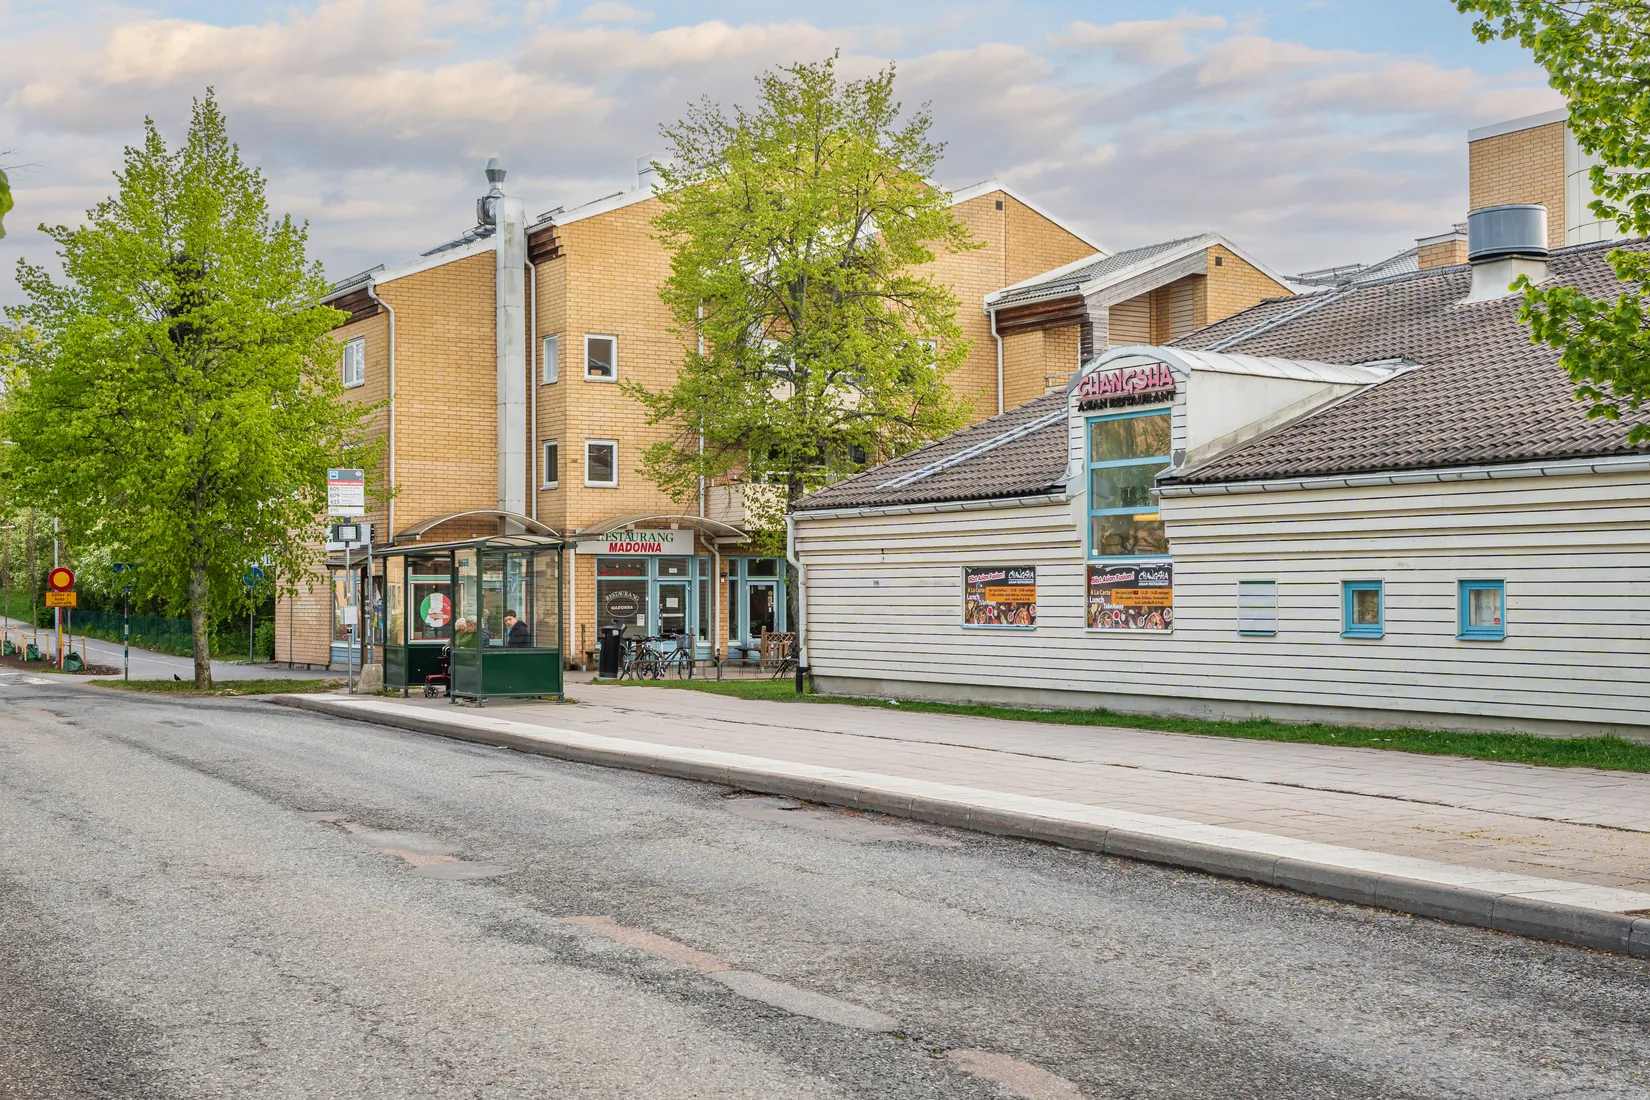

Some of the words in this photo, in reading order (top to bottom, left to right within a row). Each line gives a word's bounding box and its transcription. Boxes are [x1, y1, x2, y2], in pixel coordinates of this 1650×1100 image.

[1078, 362, 1174, 397] CHANGSHA
[1108, 390, 1175, 409] RESTAURANT
[601, 532, 674, 542] ESTAURANG
[609, 542, 662, 552] MADONNA
[1138, 568, 1169, 580] CHANGSHA
[605, 591, 640, 601] RESTAURANG
